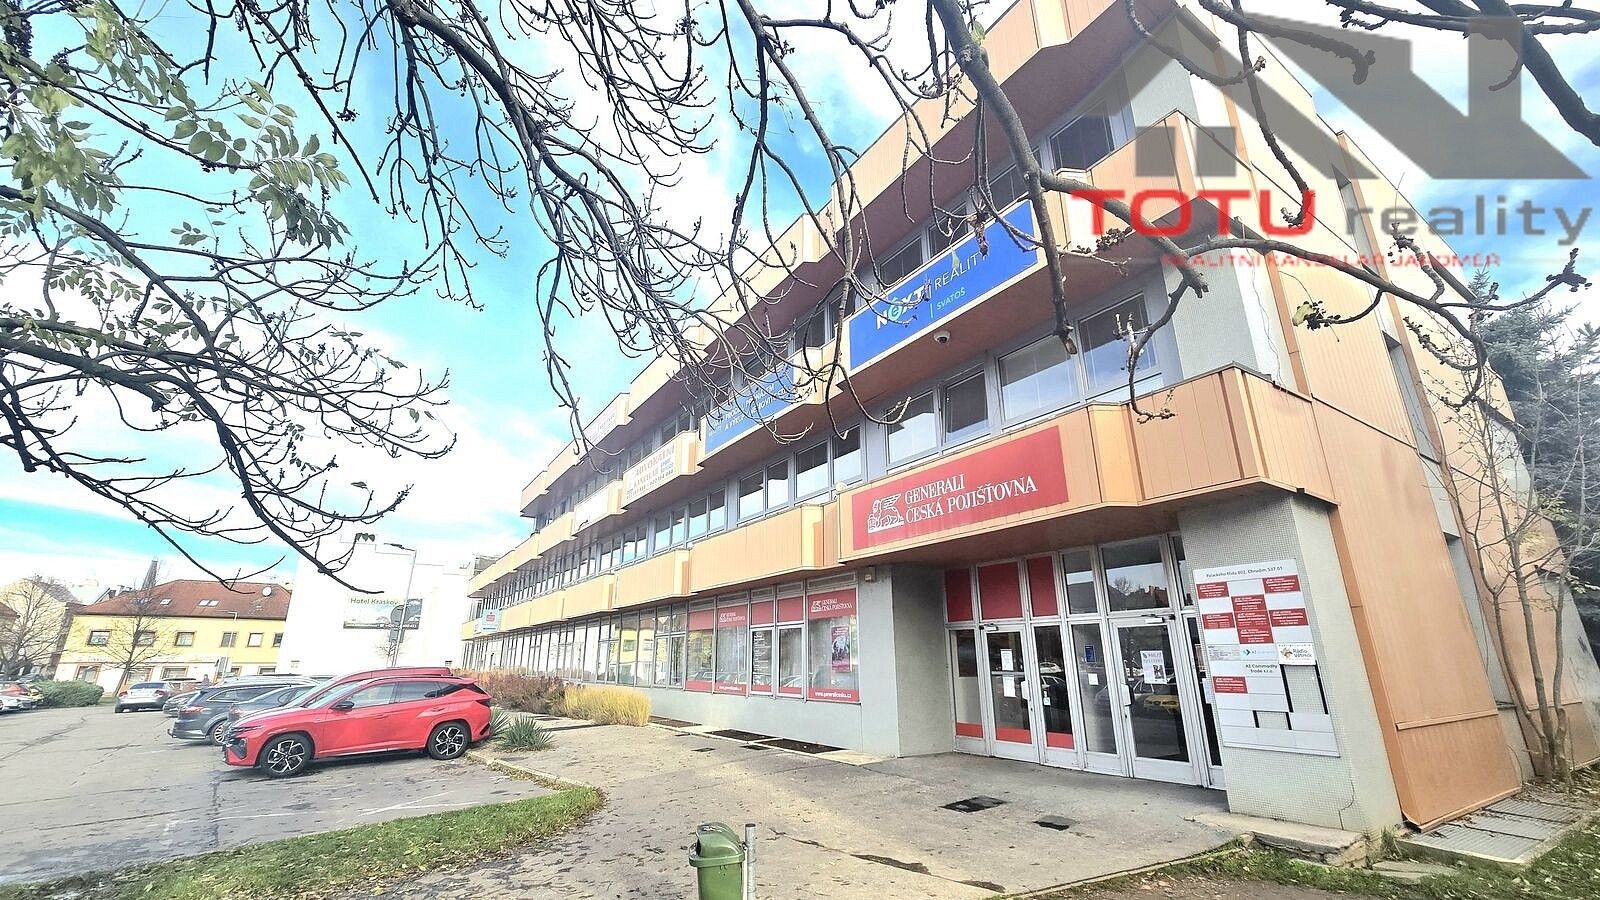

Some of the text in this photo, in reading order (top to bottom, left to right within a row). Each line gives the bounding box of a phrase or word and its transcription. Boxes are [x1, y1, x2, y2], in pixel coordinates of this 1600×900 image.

[904, 474, 965, 505] GENERALI
[905, 475, 1038, 524] ČESKÁ POJIŠŤOVNA
